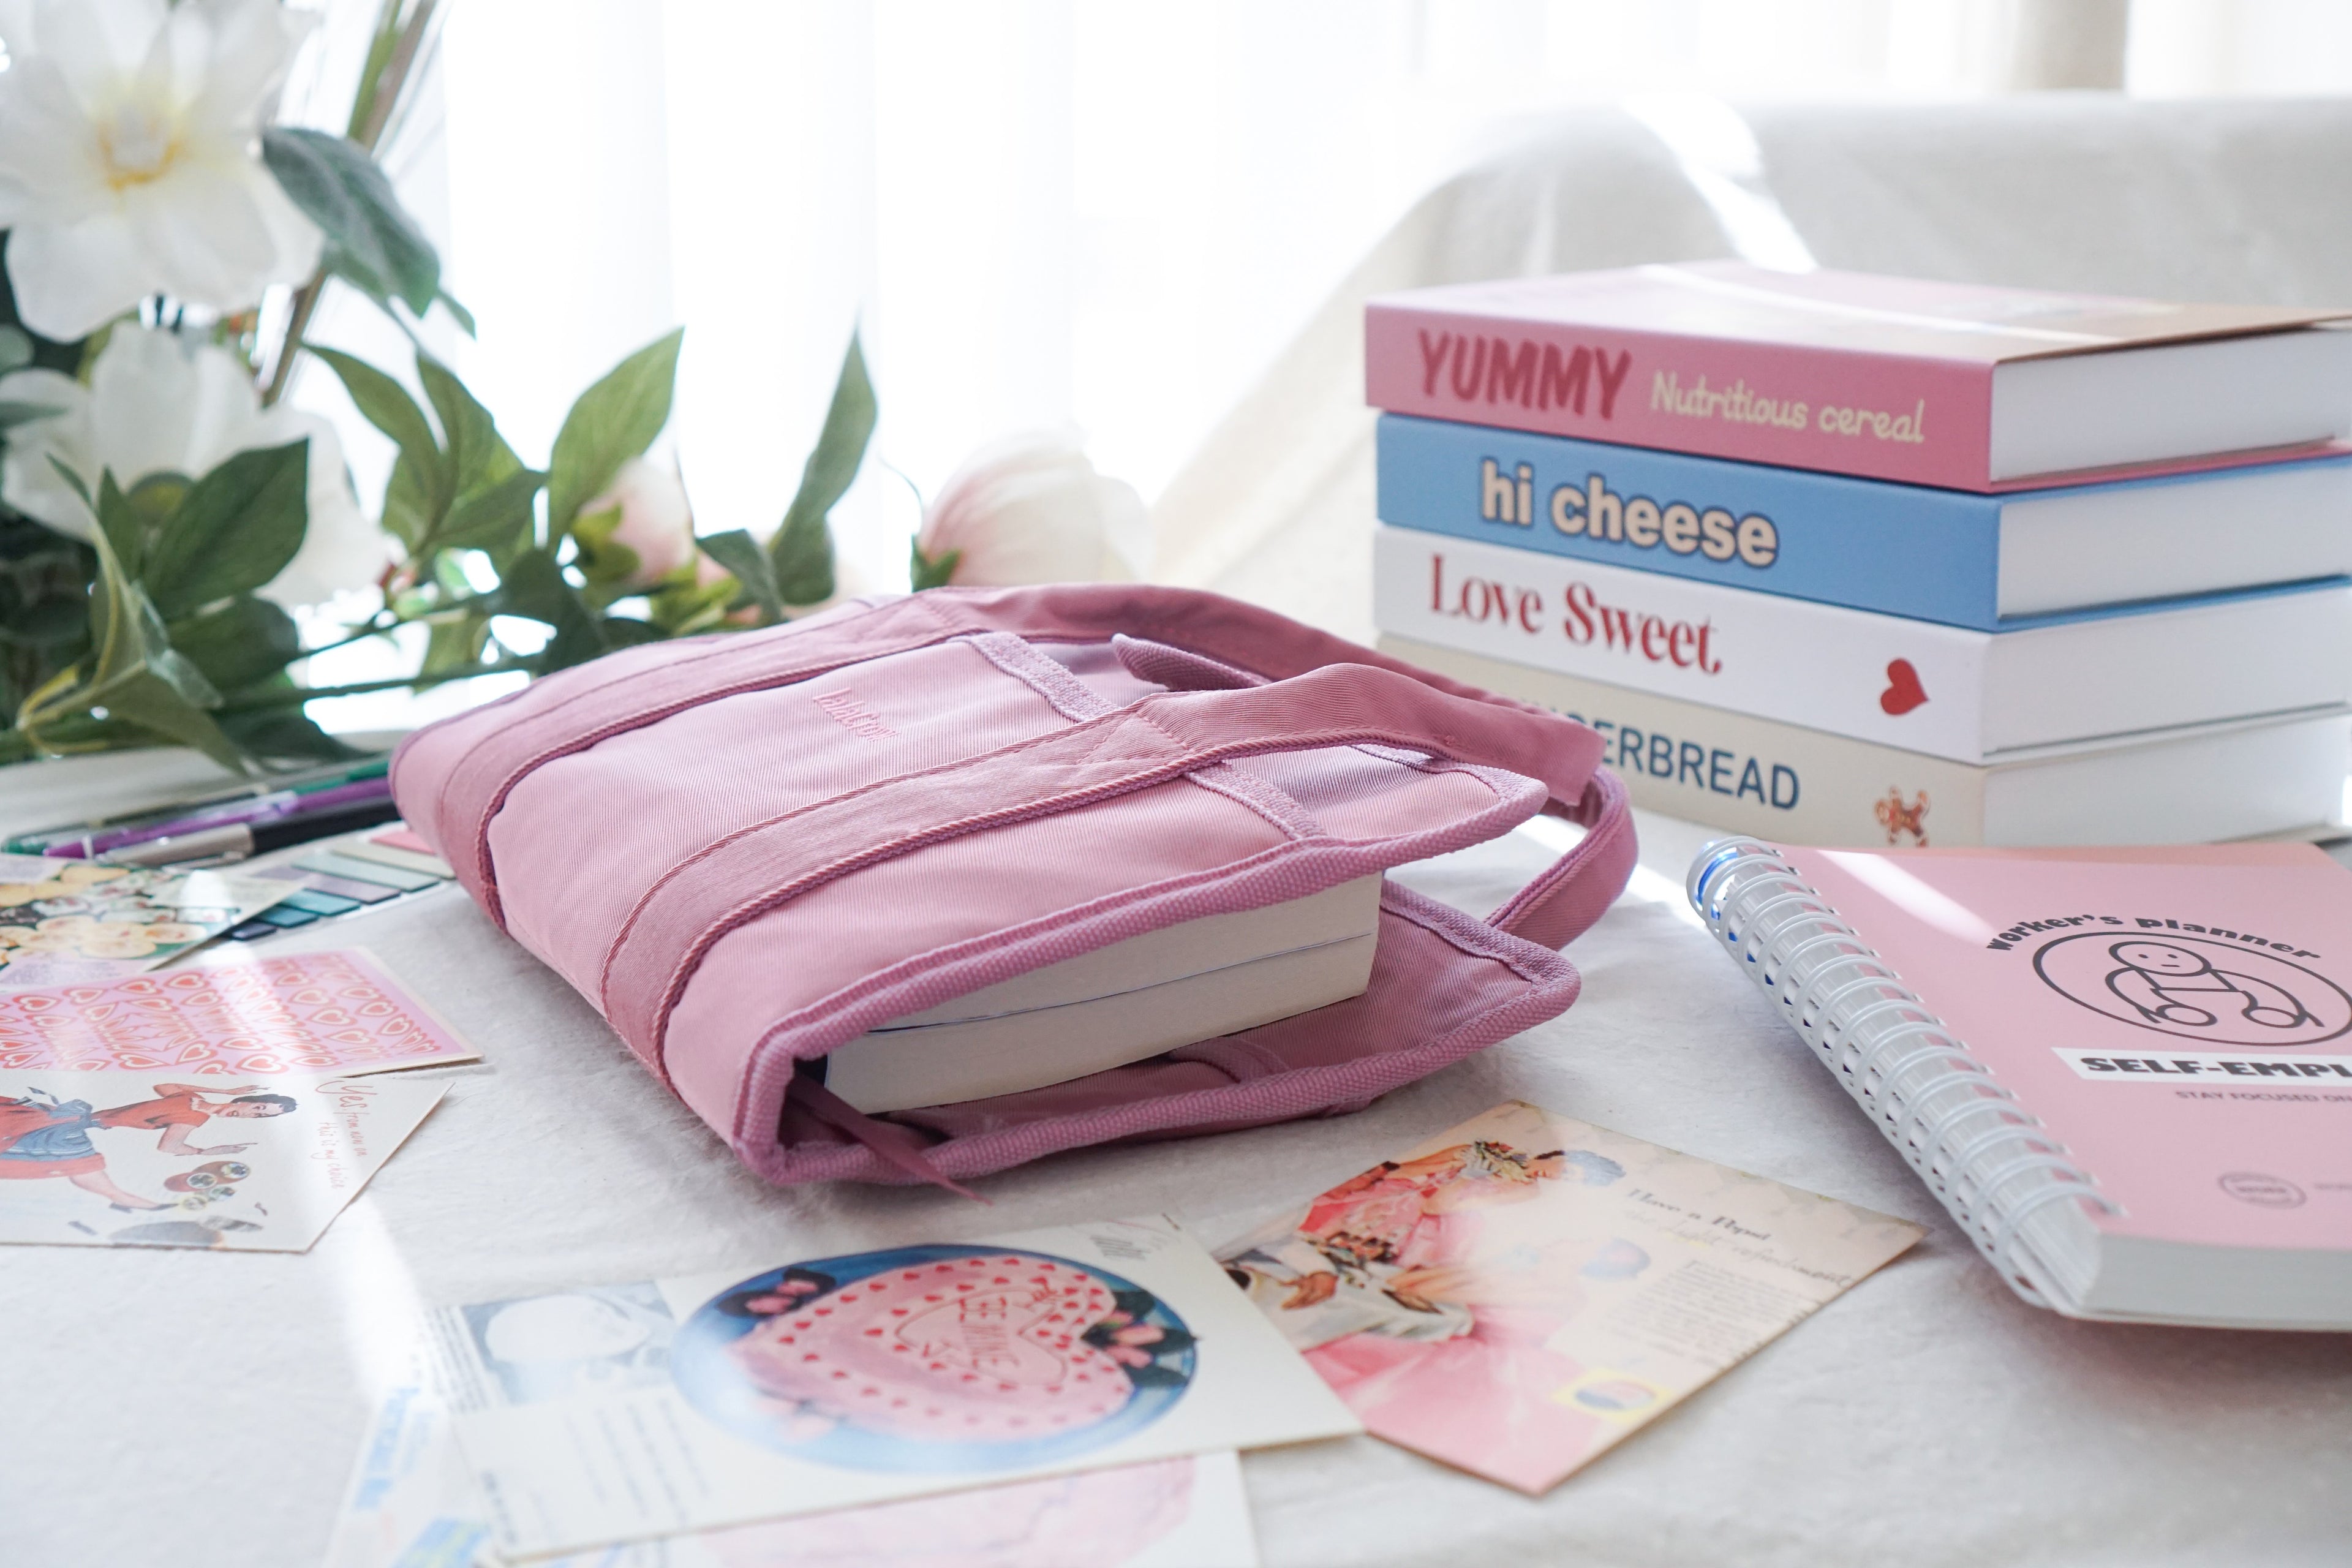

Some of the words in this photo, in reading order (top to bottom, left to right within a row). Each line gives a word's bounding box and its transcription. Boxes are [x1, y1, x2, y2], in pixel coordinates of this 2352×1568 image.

[1418, 328, 1633, 421] YUMMY
[1650, 369, 1809, 430] Nutritious
[1818, 398, 1926, 443] cereal
[1480, 457, 1535, 528] hi
[1550, 472, 1780, 569] cheese
[1430, 555, 1544, 635] Love
[1553, 704, 1800, 811] ERBREAD
[1986, 914, 2124, 951] worker's
[2135, 918, 2321, 959] planner
[2176, 1091, 2223, 1099] STAY
[2228, 1092, 2319, 1102] FOCUSED
[350, 1131, 364, 1144] now
